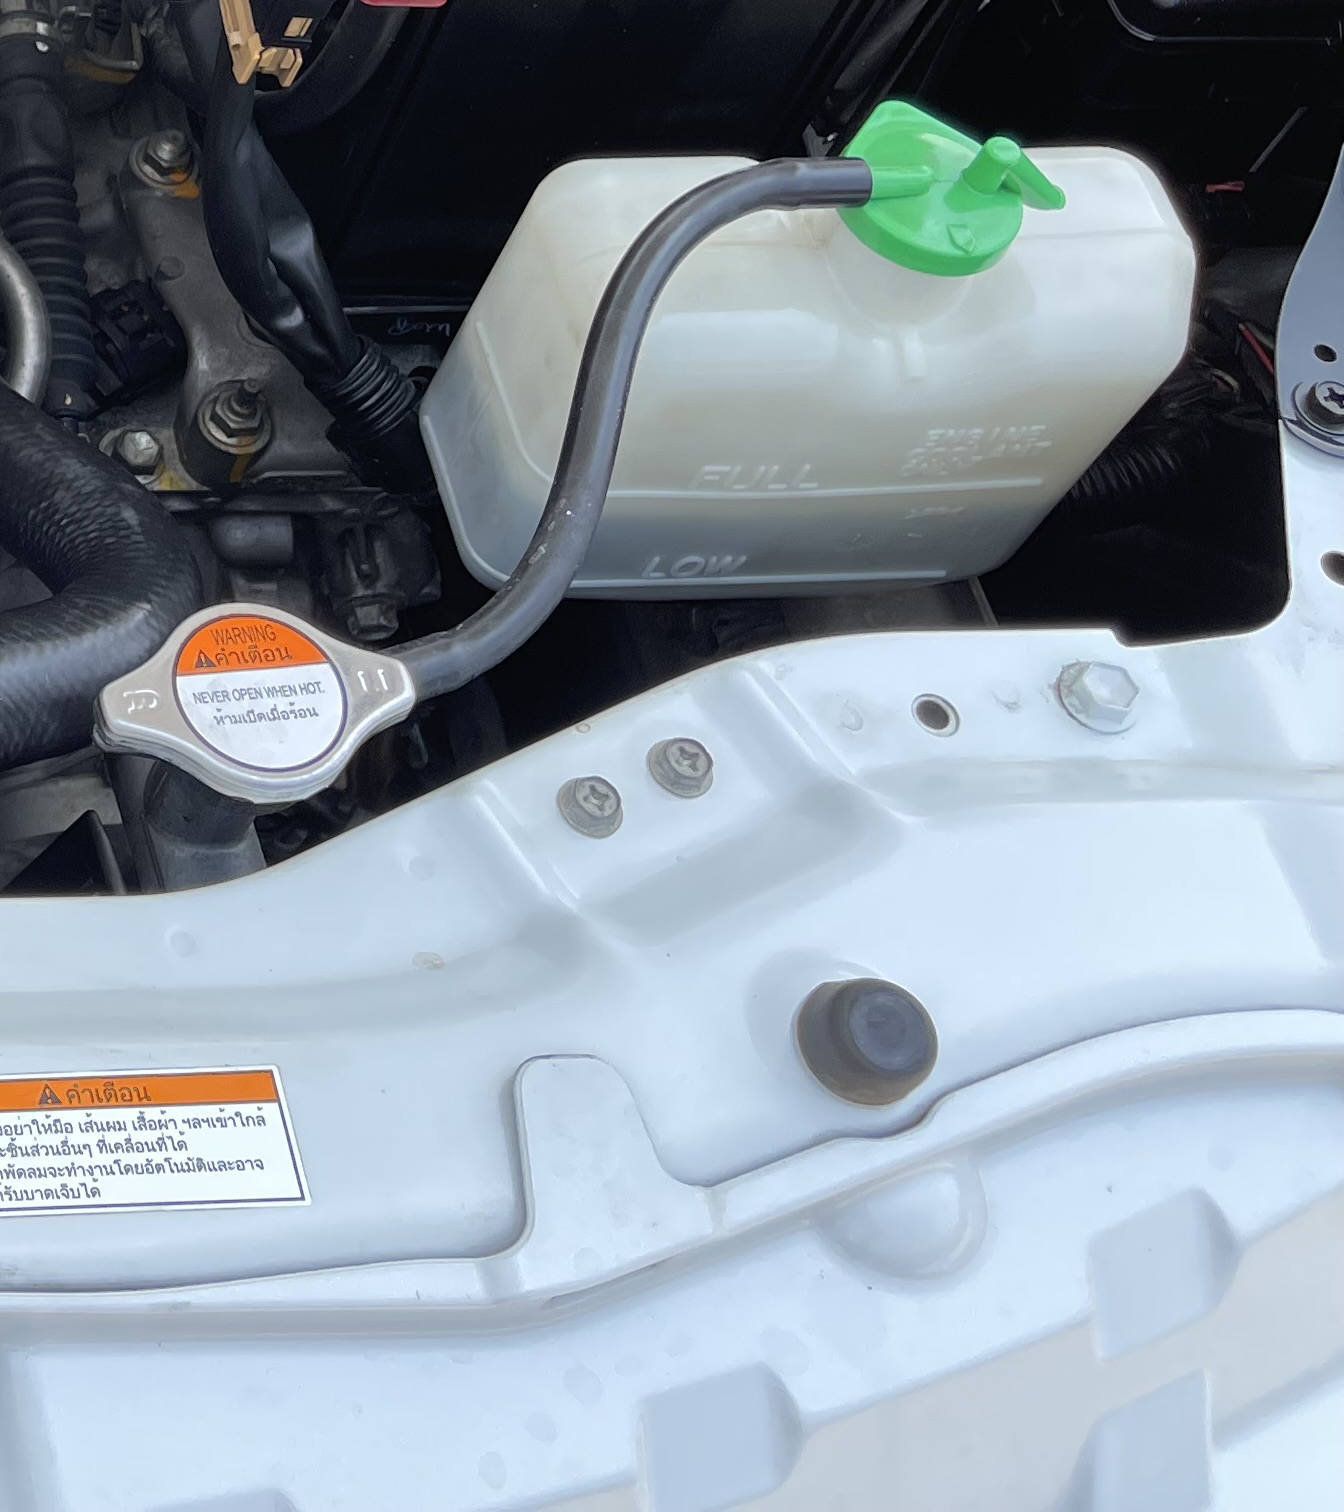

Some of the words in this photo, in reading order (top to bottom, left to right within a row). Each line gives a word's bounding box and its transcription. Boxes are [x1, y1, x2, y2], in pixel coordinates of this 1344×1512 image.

[689, 463, 819, 489] FULL
[641, 553, 749, 579] LOW
[209, 624, 277, 646] WARNING
[215, 644, 293, 667] คำเตือน
[193, 690, 232, 705] NEVER
[232, 687, 263, 702] OPEN
[263, 684, 298, 699] WHEN
[65, 1080, 152, 1105] คำเตือน
